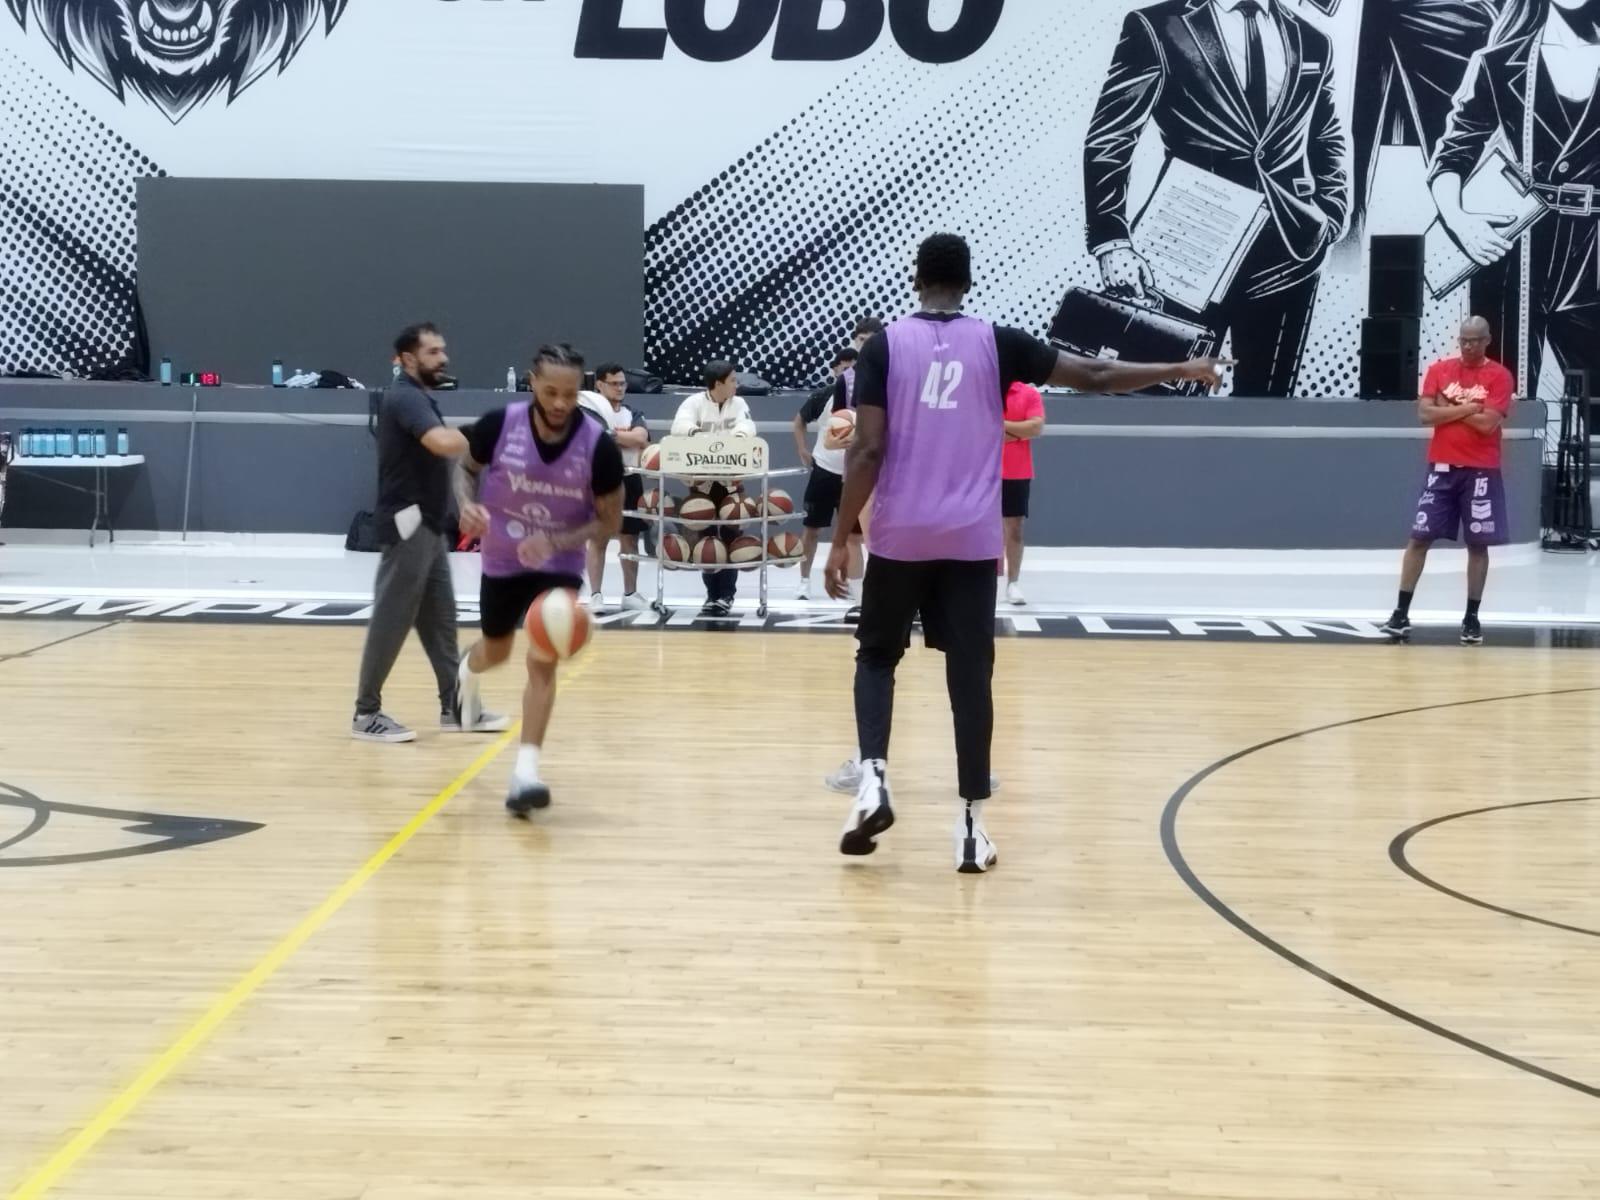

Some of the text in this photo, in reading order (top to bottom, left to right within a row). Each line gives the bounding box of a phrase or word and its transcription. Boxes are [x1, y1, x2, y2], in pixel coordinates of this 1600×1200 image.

[920, 360, 963, 409] 42
[686, 452, 748, 468] SPALDING
[1473, 476, 1489, 498] 15
